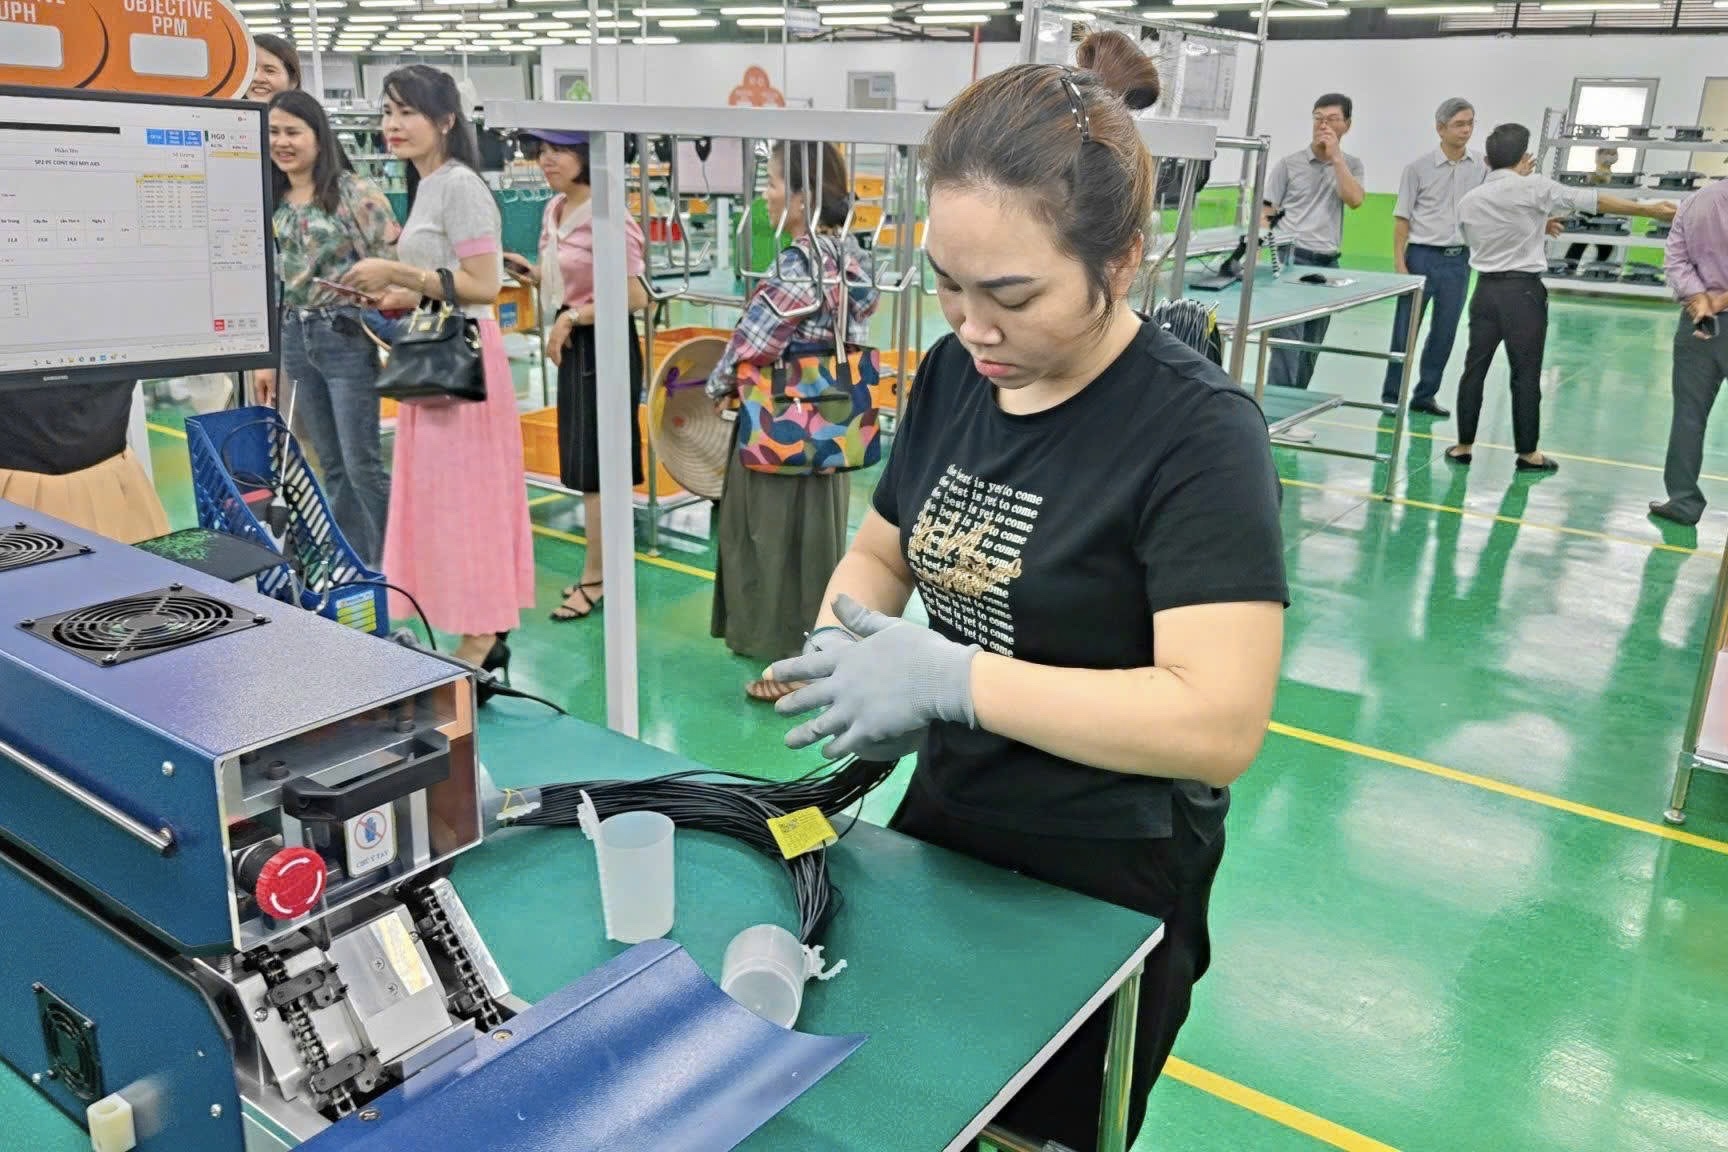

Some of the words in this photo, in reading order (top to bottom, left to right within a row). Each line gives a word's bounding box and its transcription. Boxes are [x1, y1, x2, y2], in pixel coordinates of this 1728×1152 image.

[123, 0, 213, 20] OBJECTIVE
[152, 15, 188, 37] PPM
[948, 480, 969, 498] best
[971, 489, 983, 502] is
[981, 495, 998, 507] yet
[999, 498, 1011, 511] to
[1011, 504, 1039, 519] come
[956, 468, 973, 486] best
[974, 476, 985, 489] is
[987, 482, 1005, 495] yet
[1003, 485, 1014, 497] to
[1015, 490, 1043, 506] come
[943, 491, 966, 511] best
[967, 501, 978, 515] is
[976, 508, 995, 521] yet
[994, 511, 1005, 524] to
[1004, 517, 1034, 533] come
[960, 513, 972, 527] is
[1000, 530, 1028, 545] come
[981, 537, 994, 549] to
[993, 543, 1021, 558] come
[986, 555, 1010, 568] com
[986, 584, 1009, 599] ome
[953, 608, 962, 620] is
[962, 615, 977, 628] yet
[978, 621, 989, 633] to
[989, 628, 1015, 646] come
[960, 604, 976, 616] yet
[976, 609, 987, 621] to
[989, 616, 1015, 633] come
[985, 605, 1013, 621] come
[954, 620, 963, 632] is
[963, 626, 977, 640] yet
[978, 633, 988, 646] to
[989, 640, 1014, 658] come
